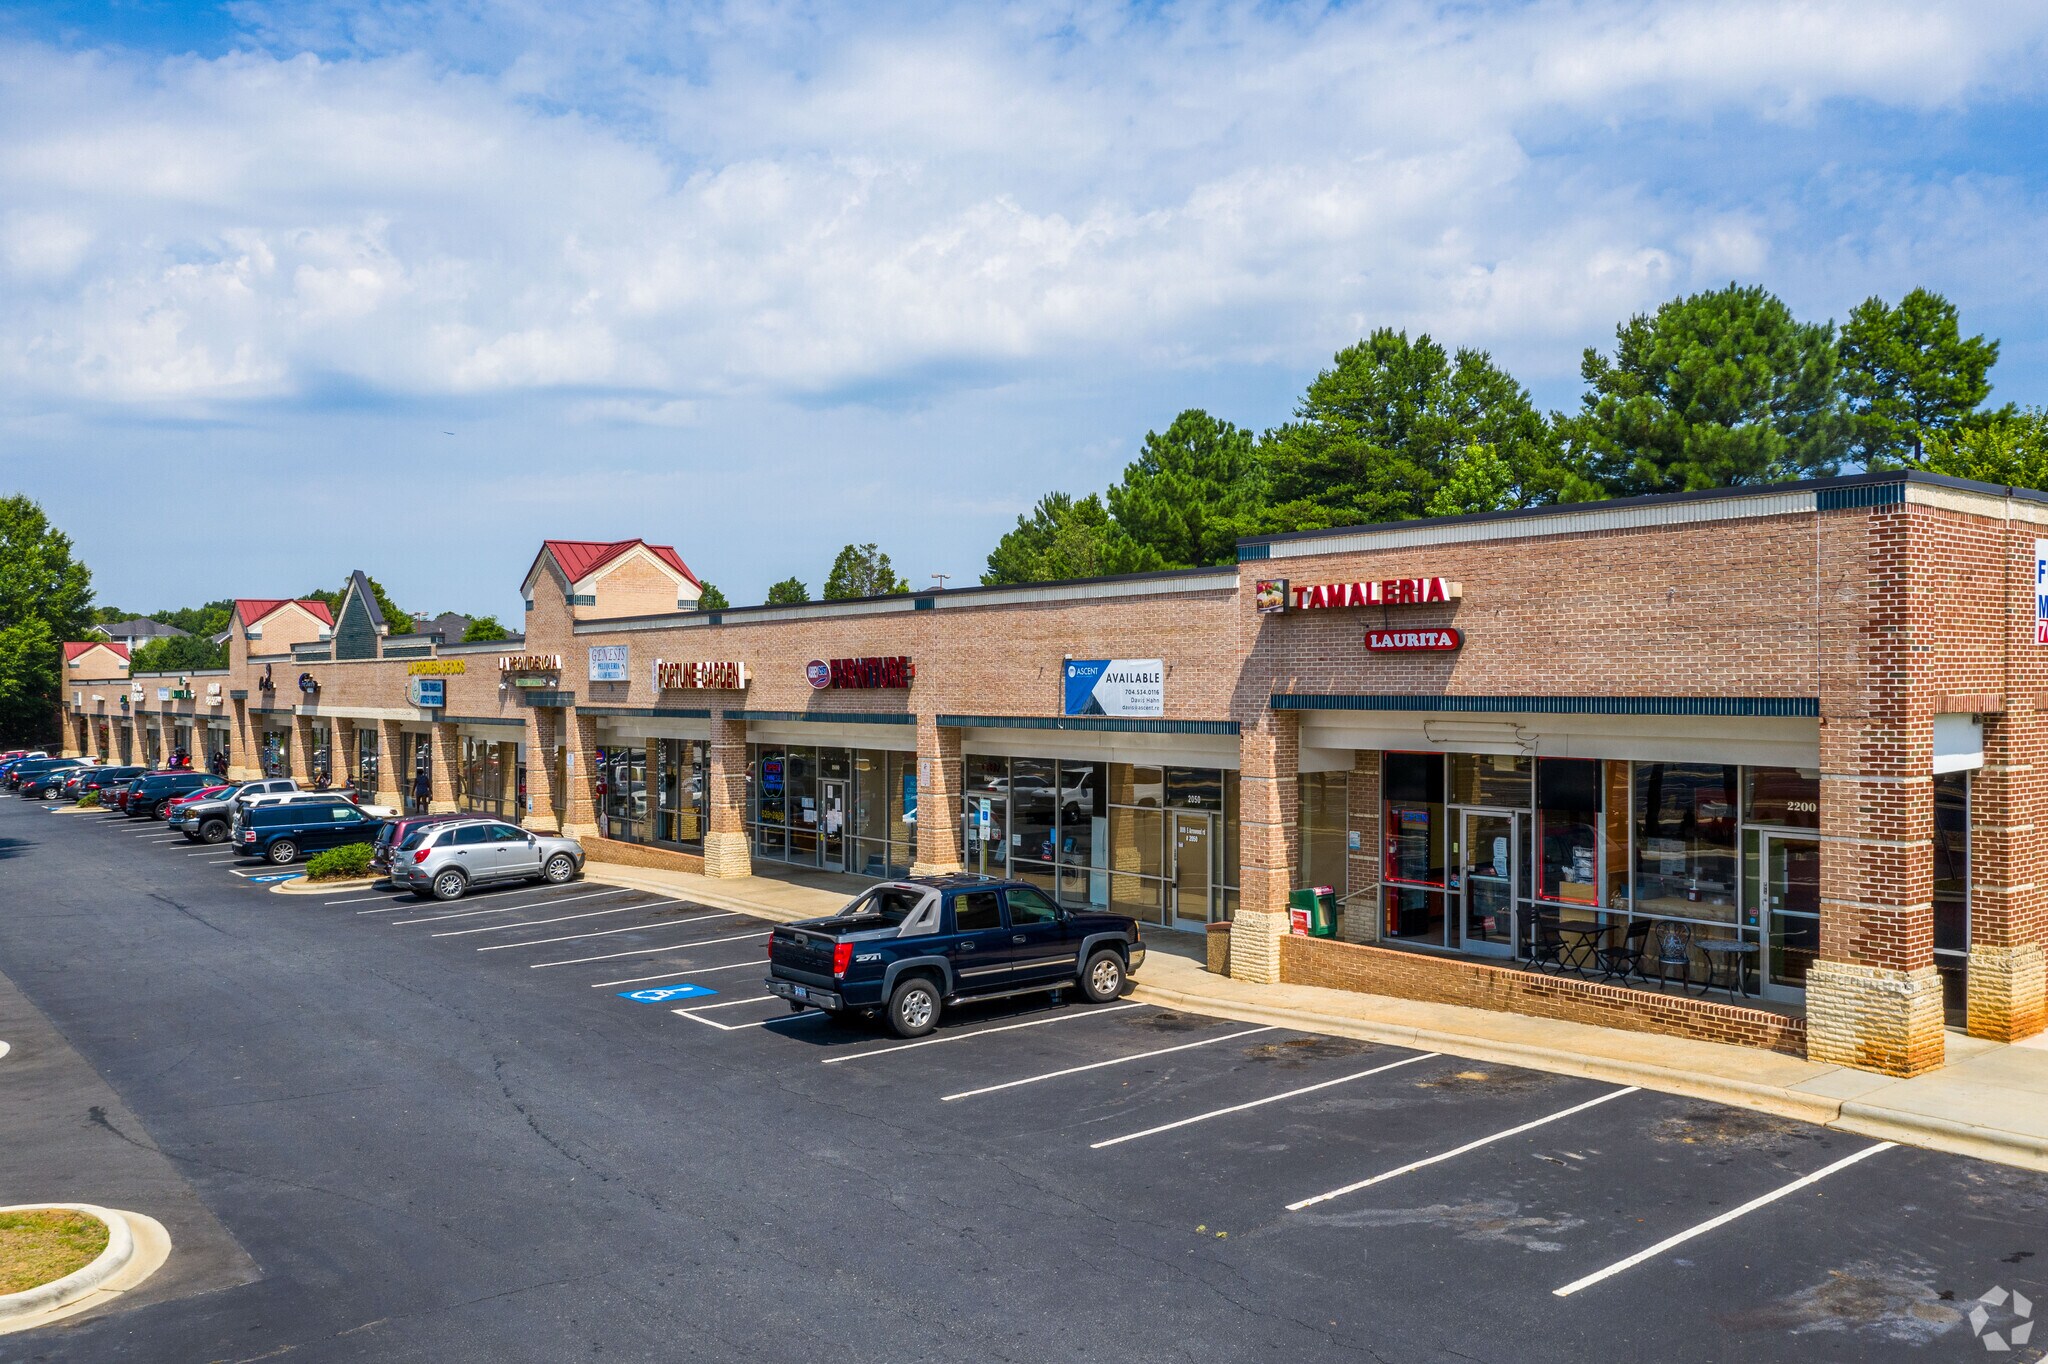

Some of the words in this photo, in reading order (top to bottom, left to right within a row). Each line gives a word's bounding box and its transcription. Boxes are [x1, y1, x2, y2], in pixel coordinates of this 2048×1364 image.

[2038, 559, 2048, 584] F
[1293, 577, 1447, 609] TAMALERIA
[2038, 620, 2048, 643] 7
[1370, 632, 1453, 648] LAURITA
[592, 648, 625, 661] GENESIS
[407, 661, 415, 675] LA
[498, 657, 507, 670] LA
[509, 655, 557, 670] PROVIDENCIA
[658, 662, 698, 689] FORTUNE
[701, 661, 740, 689] GARDEN
[830, 656, 908, 689] FURNITURE
[1076, 667, 1098, 675] ASCENT
[1106, 673, 1160, 683] AVAILABLE
[1188, 795, 1201, 804] 2050
[1787, 802, 1817, 812] 2200
[1402, 811, 1428, 824] OPEN
[855, 953, 881, 962] Z71
